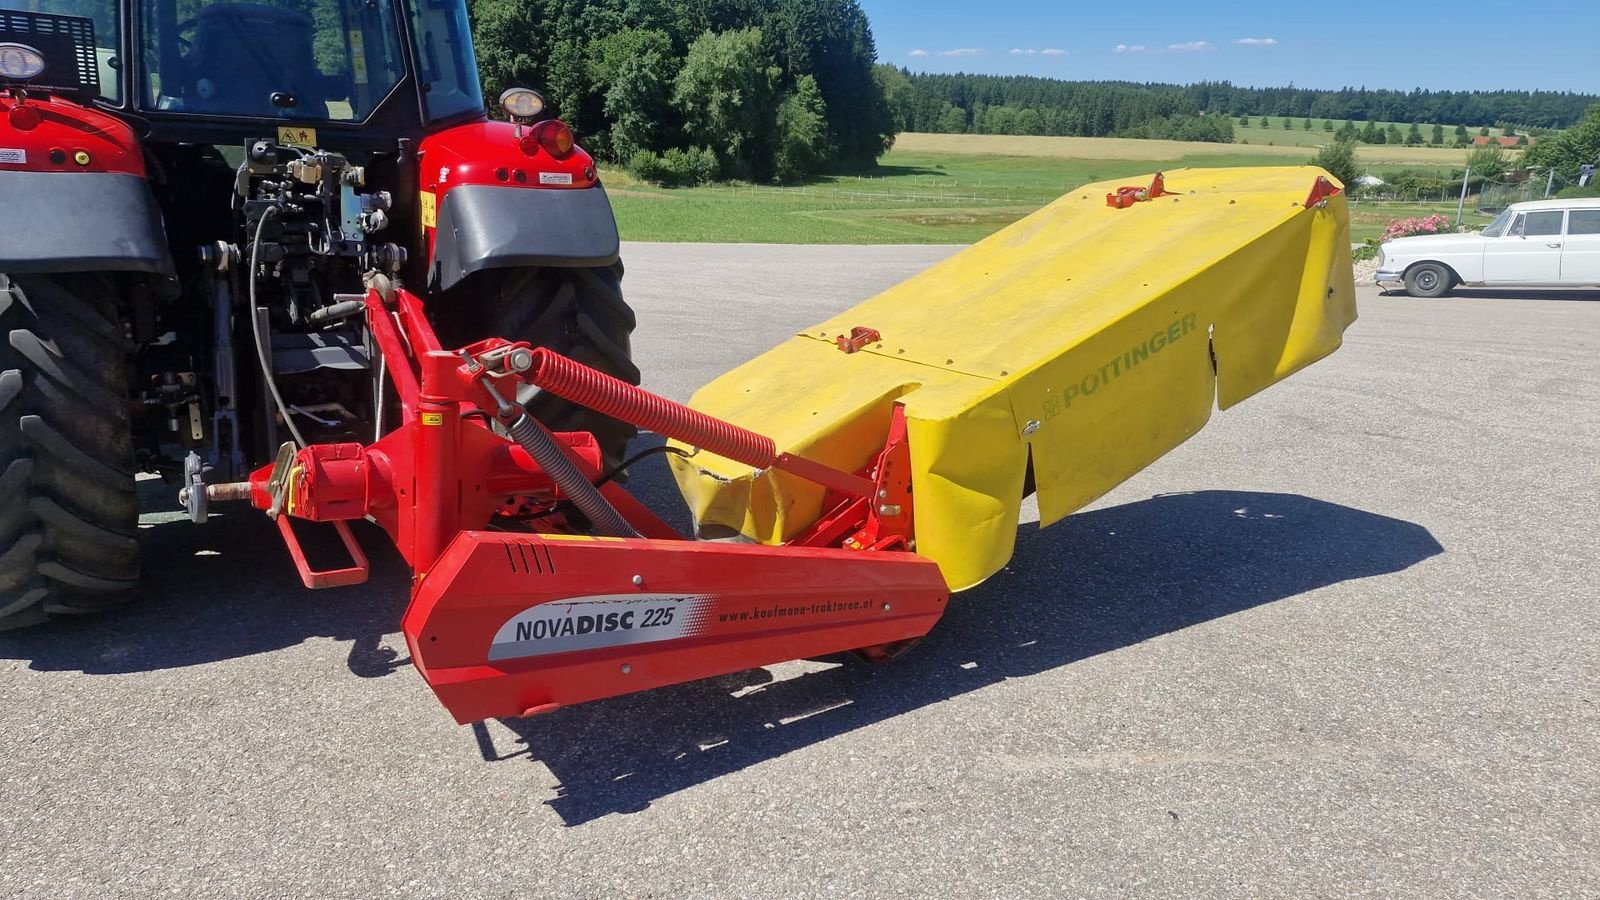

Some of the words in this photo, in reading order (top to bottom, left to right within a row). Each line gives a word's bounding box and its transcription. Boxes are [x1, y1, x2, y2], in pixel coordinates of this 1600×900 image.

[516, 611, 634, 641] NOVADISC
[640, 607, 676, 628] 225
[719, 599, 873, 622] www.kaufmann-traktoren.at
